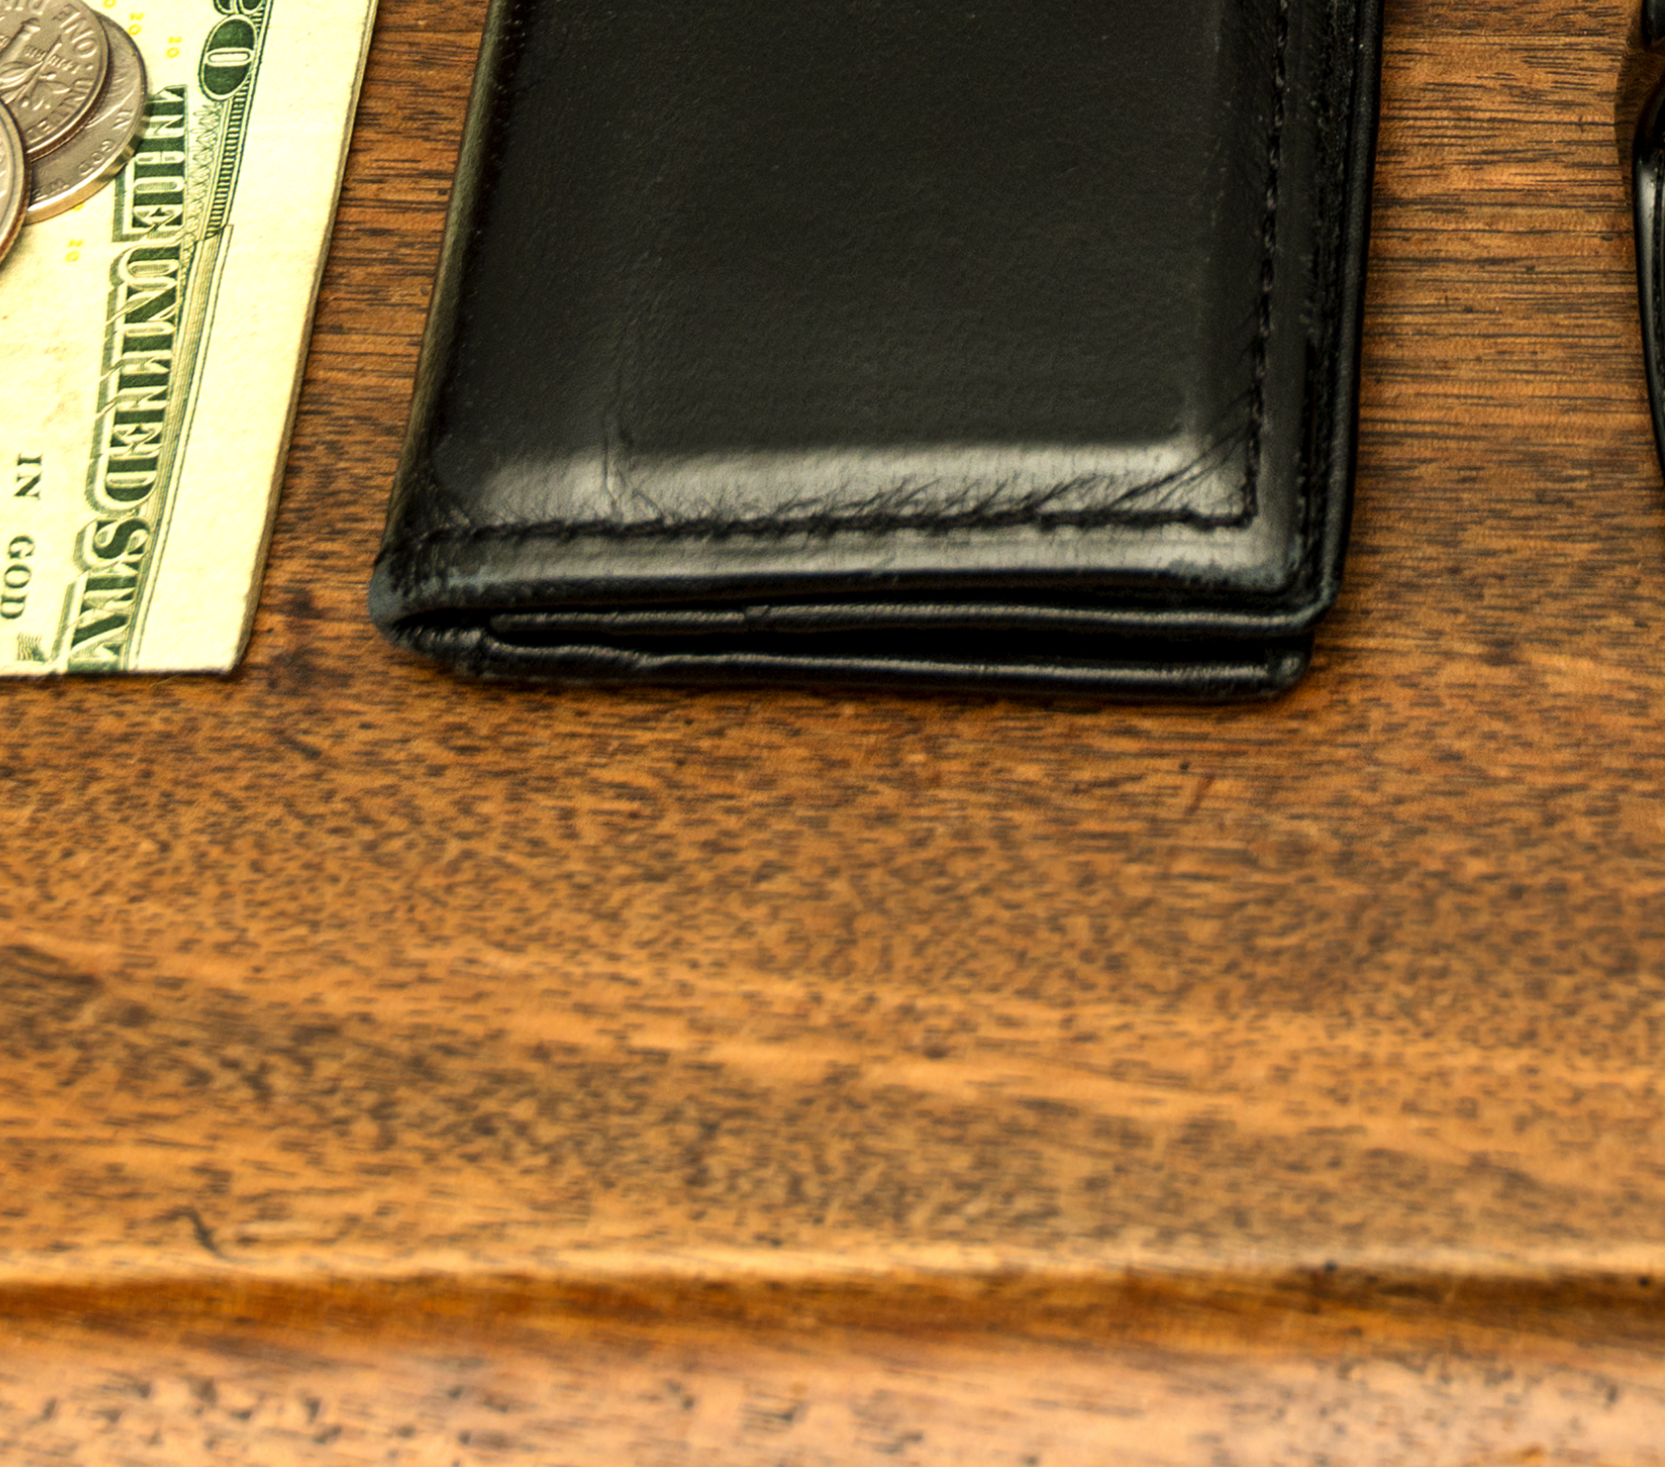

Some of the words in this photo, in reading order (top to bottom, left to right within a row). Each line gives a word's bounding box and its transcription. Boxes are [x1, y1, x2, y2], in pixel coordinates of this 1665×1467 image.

[52, 3, 98, 59] ONE
[112, 85, 187, 242] THE
[84, 239, 185, 515] UNITED
[5, 452, 43, 501] IN
[0, 535, 35, 620] GOD
